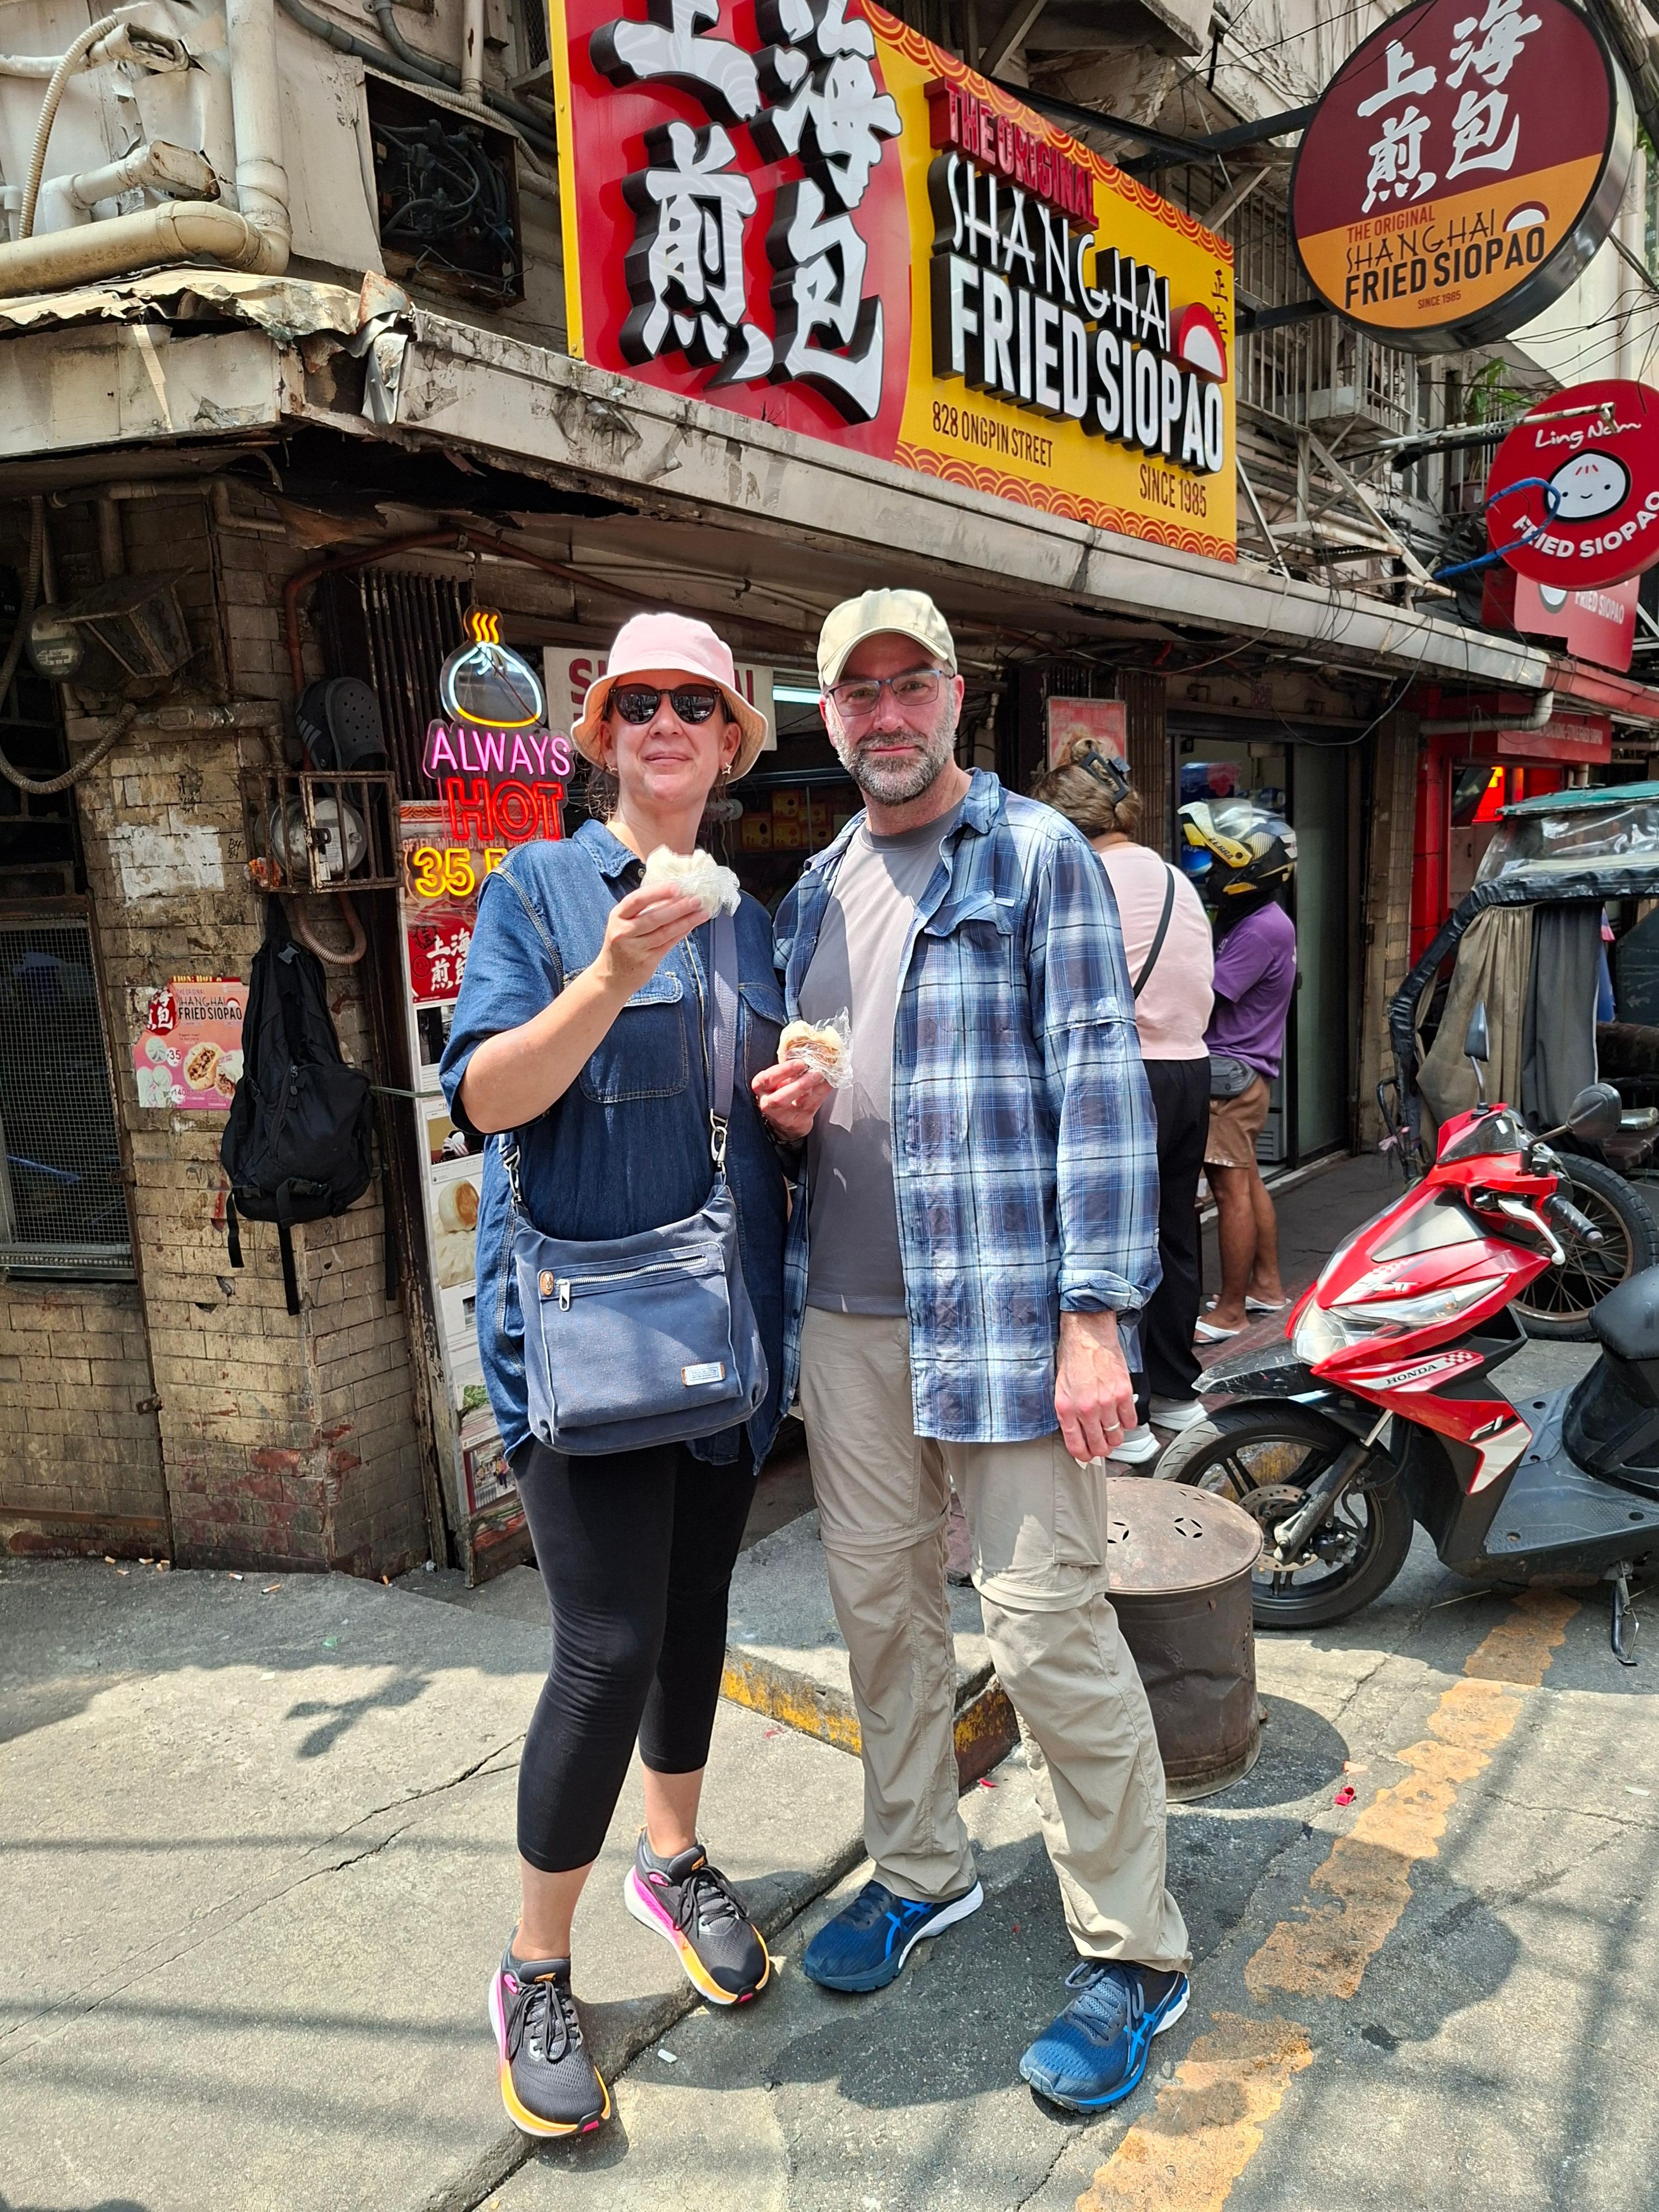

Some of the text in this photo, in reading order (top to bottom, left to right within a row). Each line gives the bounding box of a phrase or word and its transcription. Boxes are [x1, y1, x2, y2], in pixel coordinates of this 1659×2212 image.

[1358, 0, 1542, 116] 上海
[946, 85, 1097, 226] THE ORIGINAL
[1361, 90, 1519, 213] 煎包
[946, 152, 1170, 351] SHANGHAI
[1347, 208, 1494, 274] SHANGHAI
[1348, 206, 1436, 243] THE ORIGINAL
[643, 121, 883, 419] 煎包
[1345, 227, 1545, 309] FRIED SIOPAO
[1418, 291, 1461, 309] SINCE 1985
[950, 253, 1223, 472] FRIED SIOPAO
[932, 401, 1053, 467] 828 ONGPIN STREET
[1535, 429, 1584, 450] Ling
[1140, 464, 1207, 517] SINCE 1985
[1579, 491, 1659, 557] SIOPAO
[1575, 591, 1624, 624] FRIED SIOPAO
[431, 727, 571, 776] ALWAYS
[446, 777, 564, 841] HOT
[413, 847, 476, 897] 35
[178, 996, 226, 1006] SHANGHAI
[178, 1007, 242, 1020] FRIED SIOPAO
[1385, 1364, 1438, 1385] HONDA
